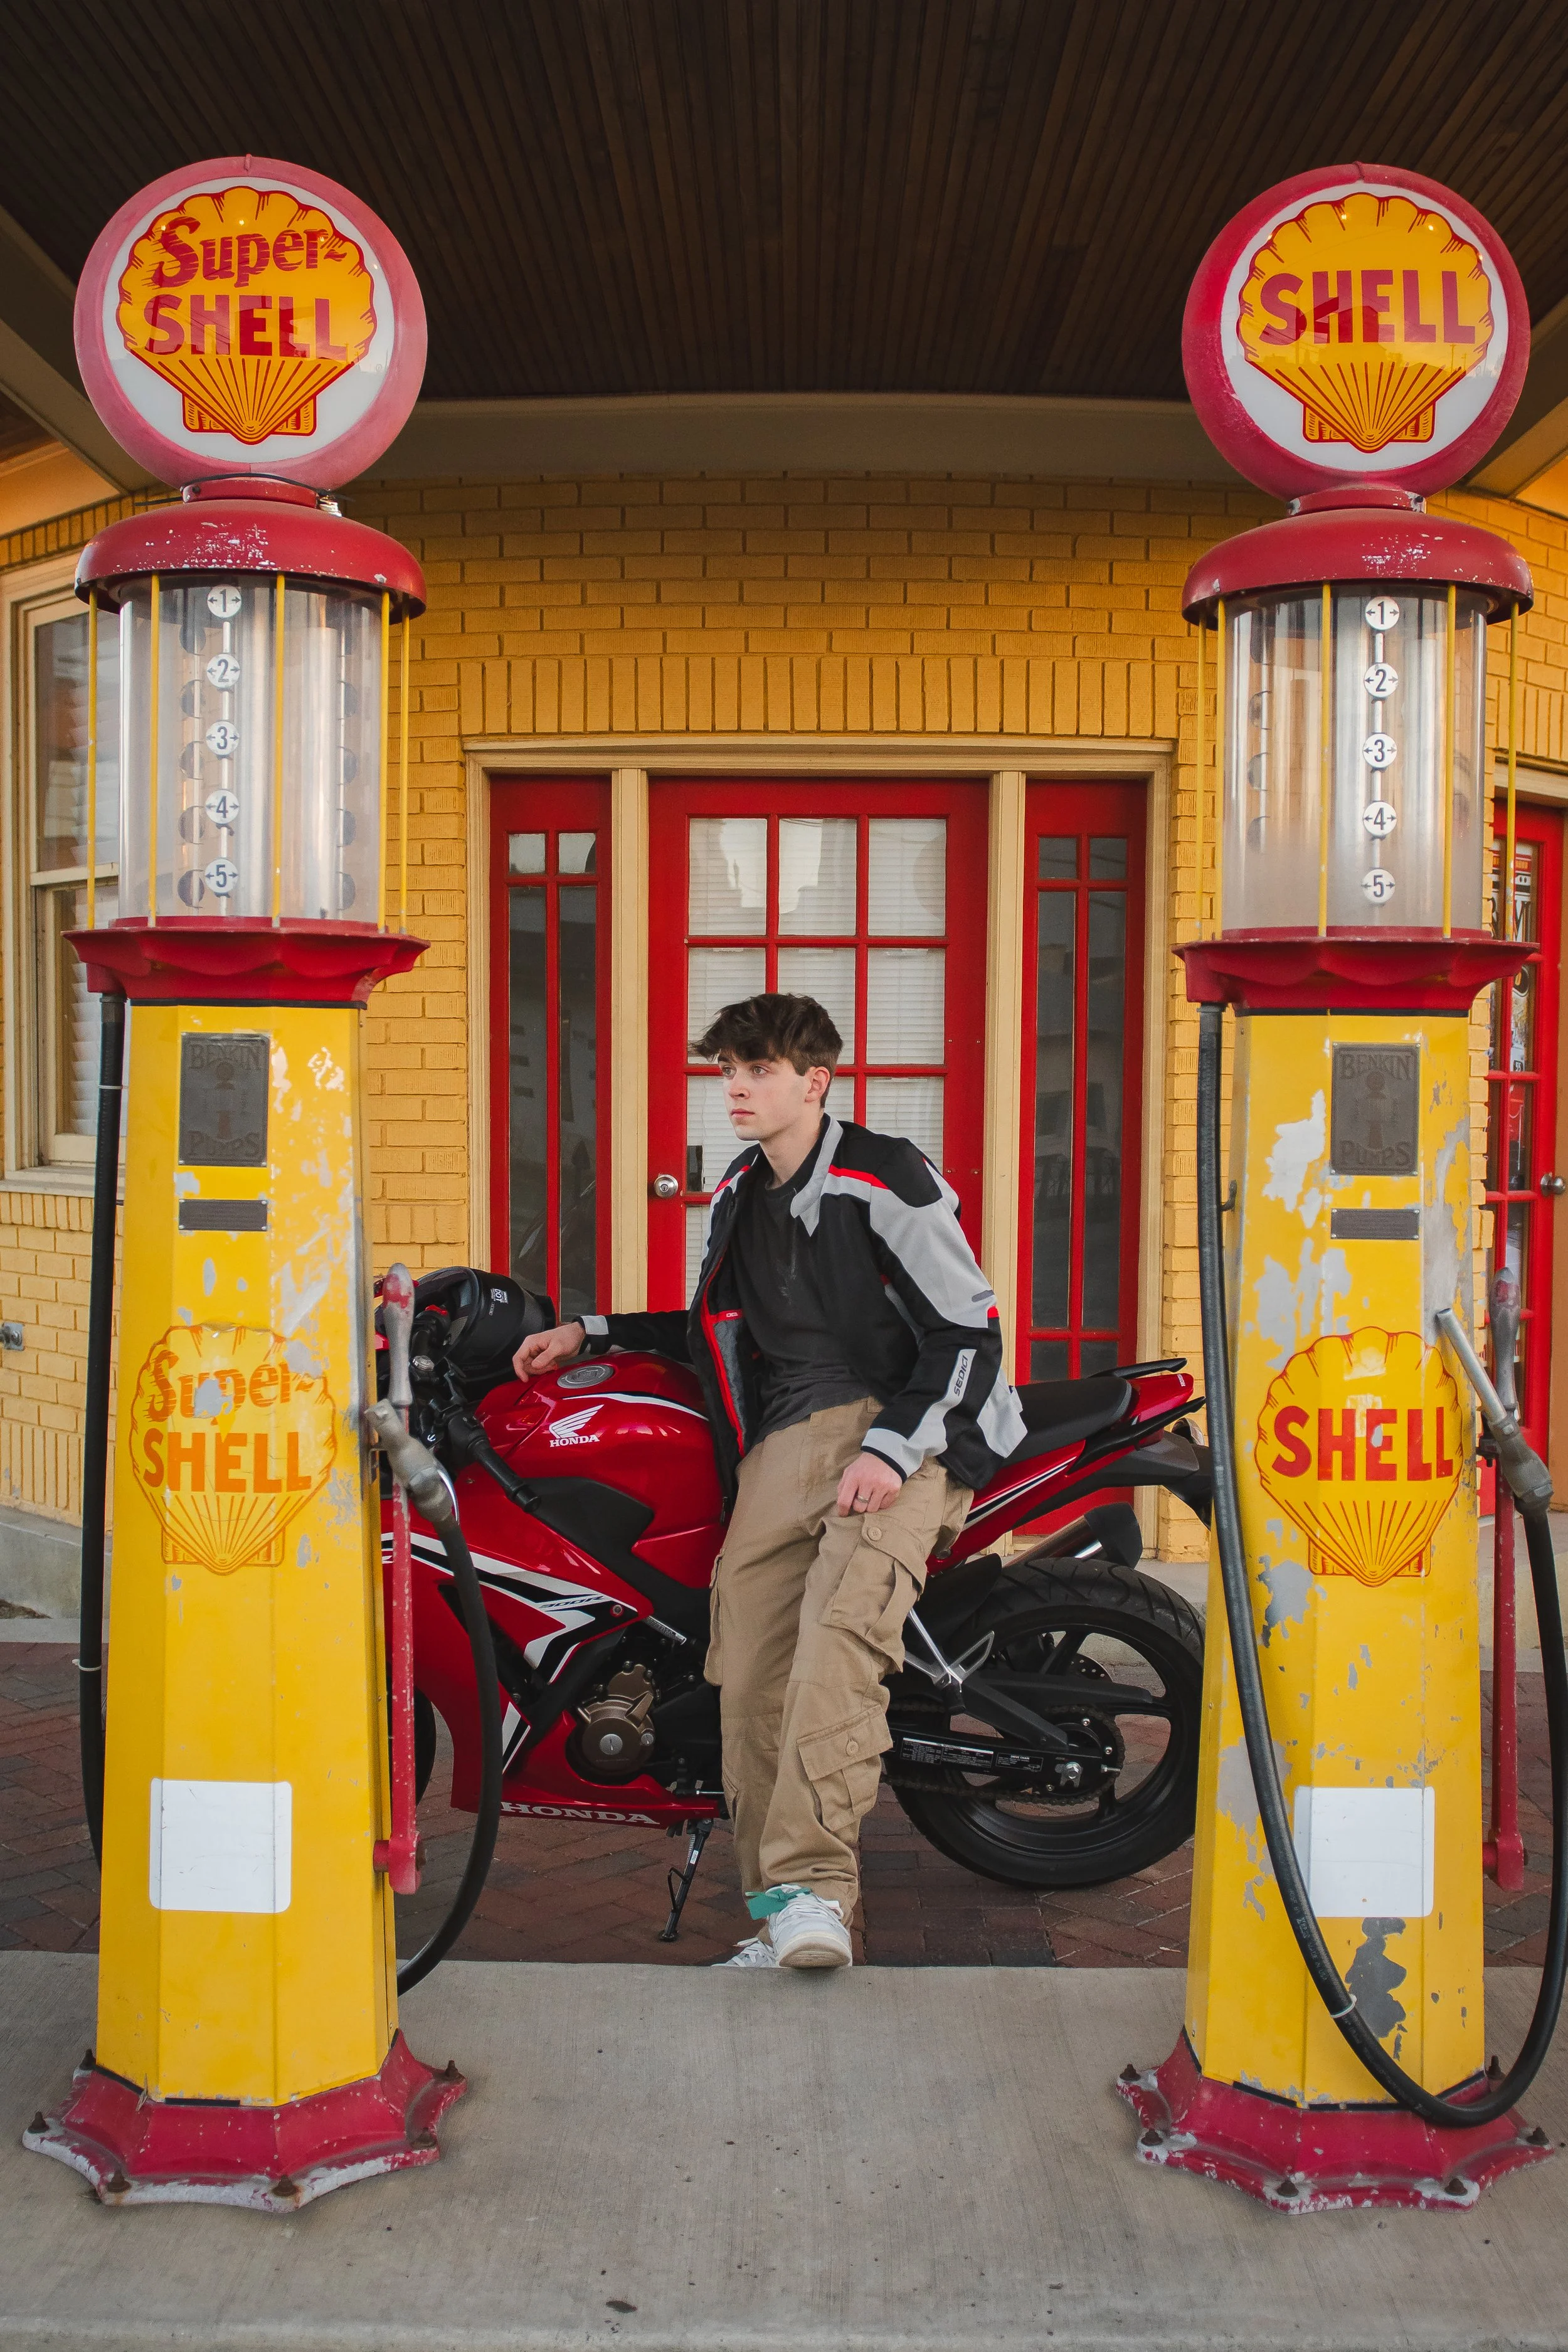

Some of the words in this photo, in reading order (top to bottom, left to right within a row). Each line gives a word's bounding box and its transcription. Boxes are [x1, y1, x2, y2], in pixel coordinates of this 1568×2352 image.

[1258, 270, 1476, 346] SHELL
[144, 294, 347, 359] SHELL
[219, 590, 227, 613] 1
[1378, 601, 1385, 625] 1
[216, 659, 230, 683] 2
[1375, 669, 1387, 692] 2
[216, 726, 228, 750] 3
[1374, 739, 1385, 763] 3
[215, 795, 229, 818] 4
[1374, 807, 1386, 831] 4
[215, 864, 227, 888] 5
[1373, 874, 1385, 898] 5
[953, 1355, 968, 1397] SEDICI
[549, 1434, 600, 1448] HONDA
[1271, 1405, 1454, 1481] SHELL
[143, 1428, 312, 1493] SHELL
[501, 1801, 660, 1825] HONDA
